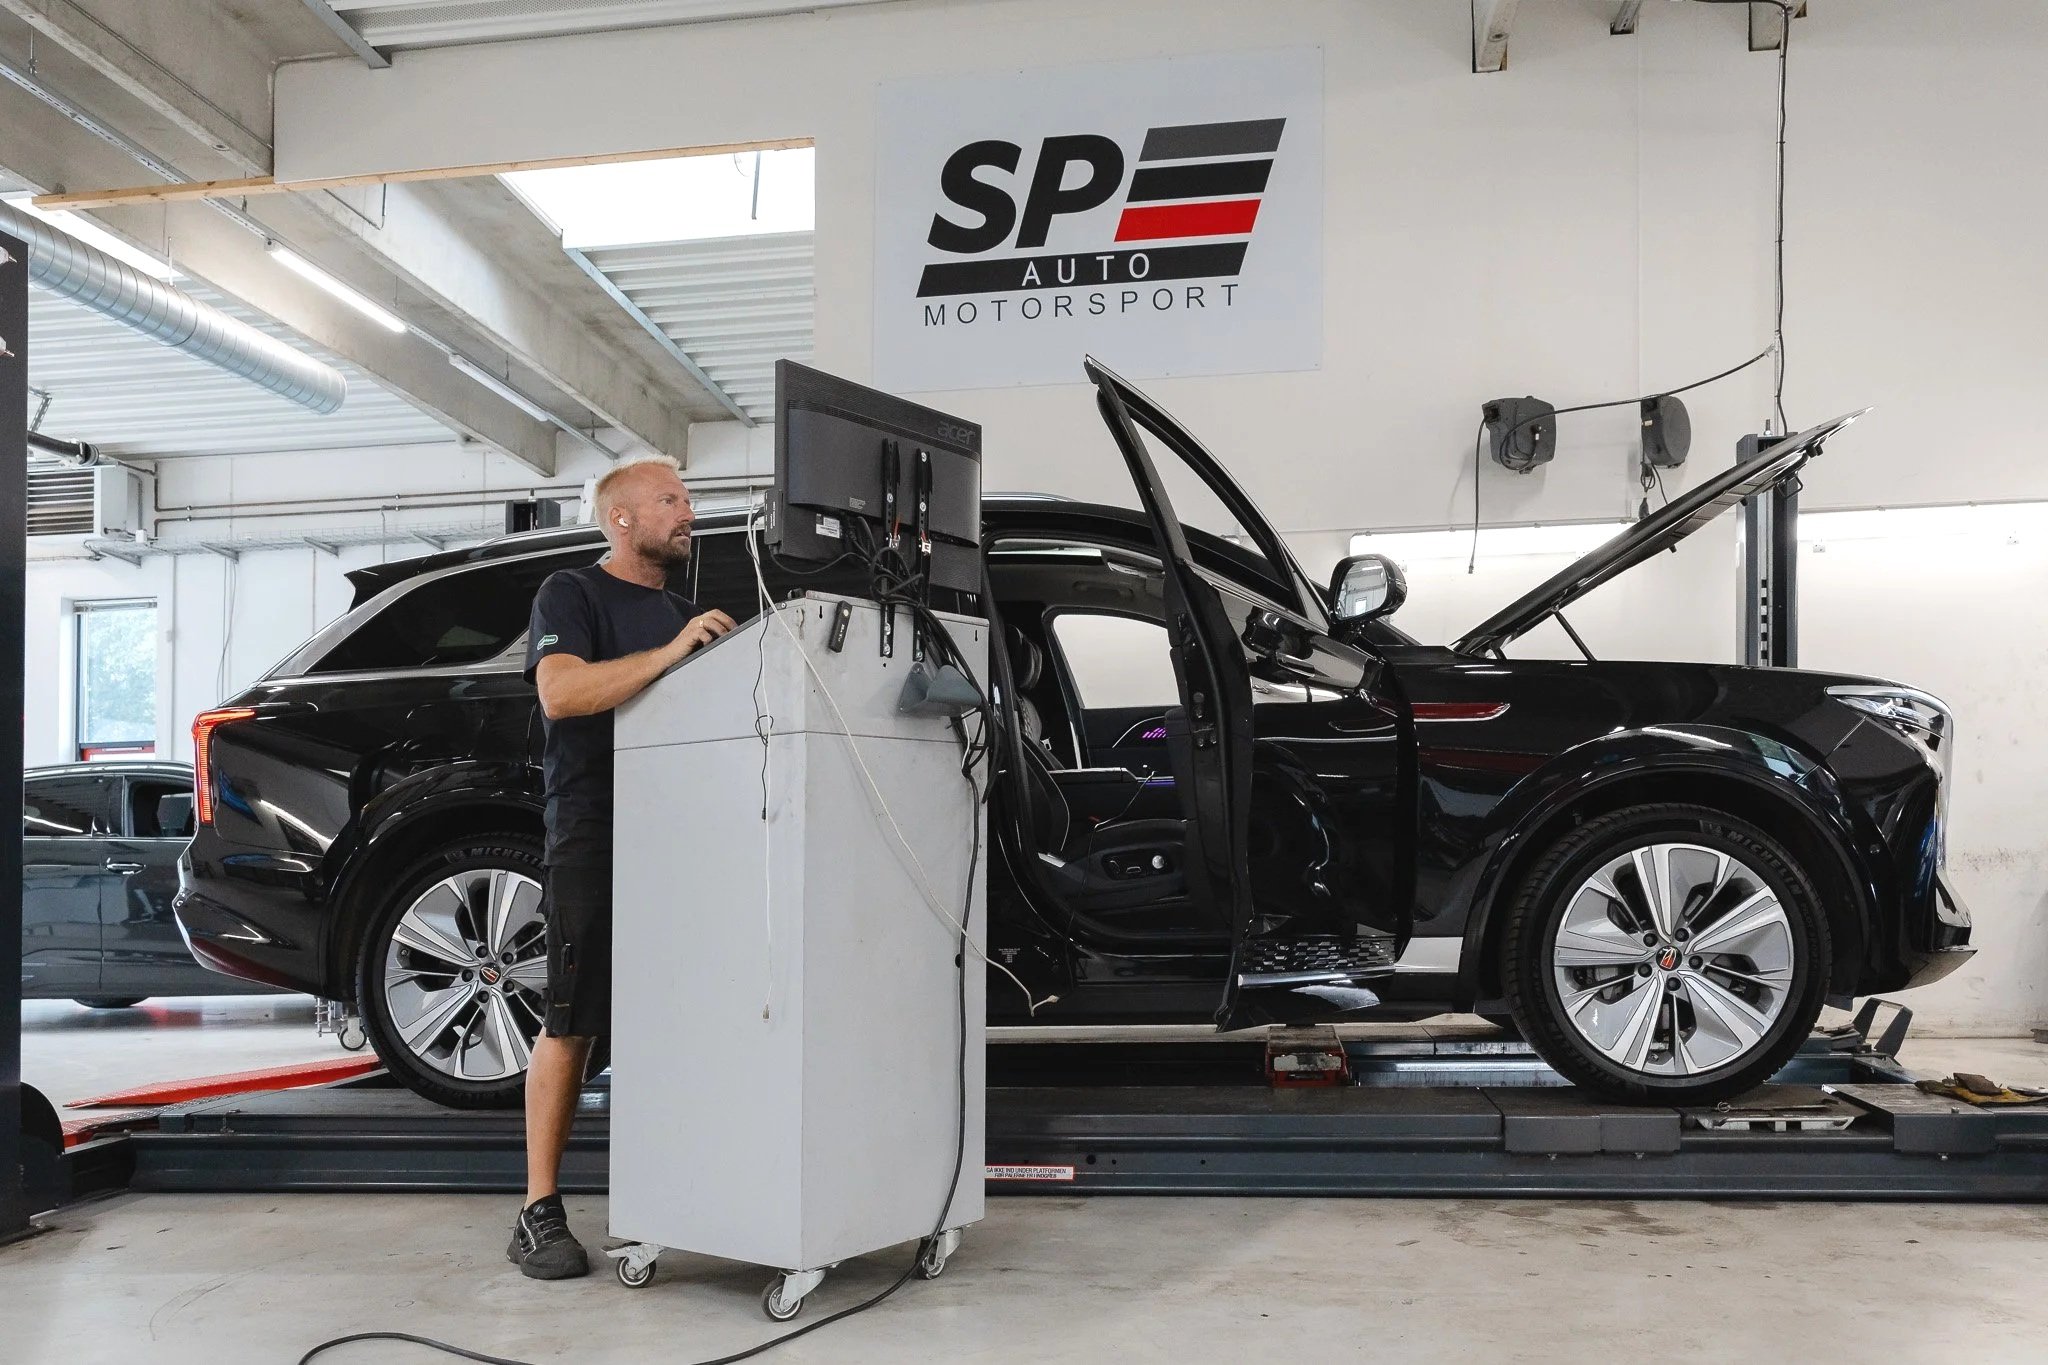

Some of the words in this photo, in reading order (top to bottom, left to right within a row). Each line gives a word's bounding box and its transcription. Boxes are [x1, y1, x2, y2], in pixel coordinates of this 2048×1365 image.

[1021, 252, 1151, 287] AUTO
[924, 284, 1239, 326] MOTORSPORT
[937, 420, 976, 445] acer
[1726, 828, 1803, 896] MICHELIN
